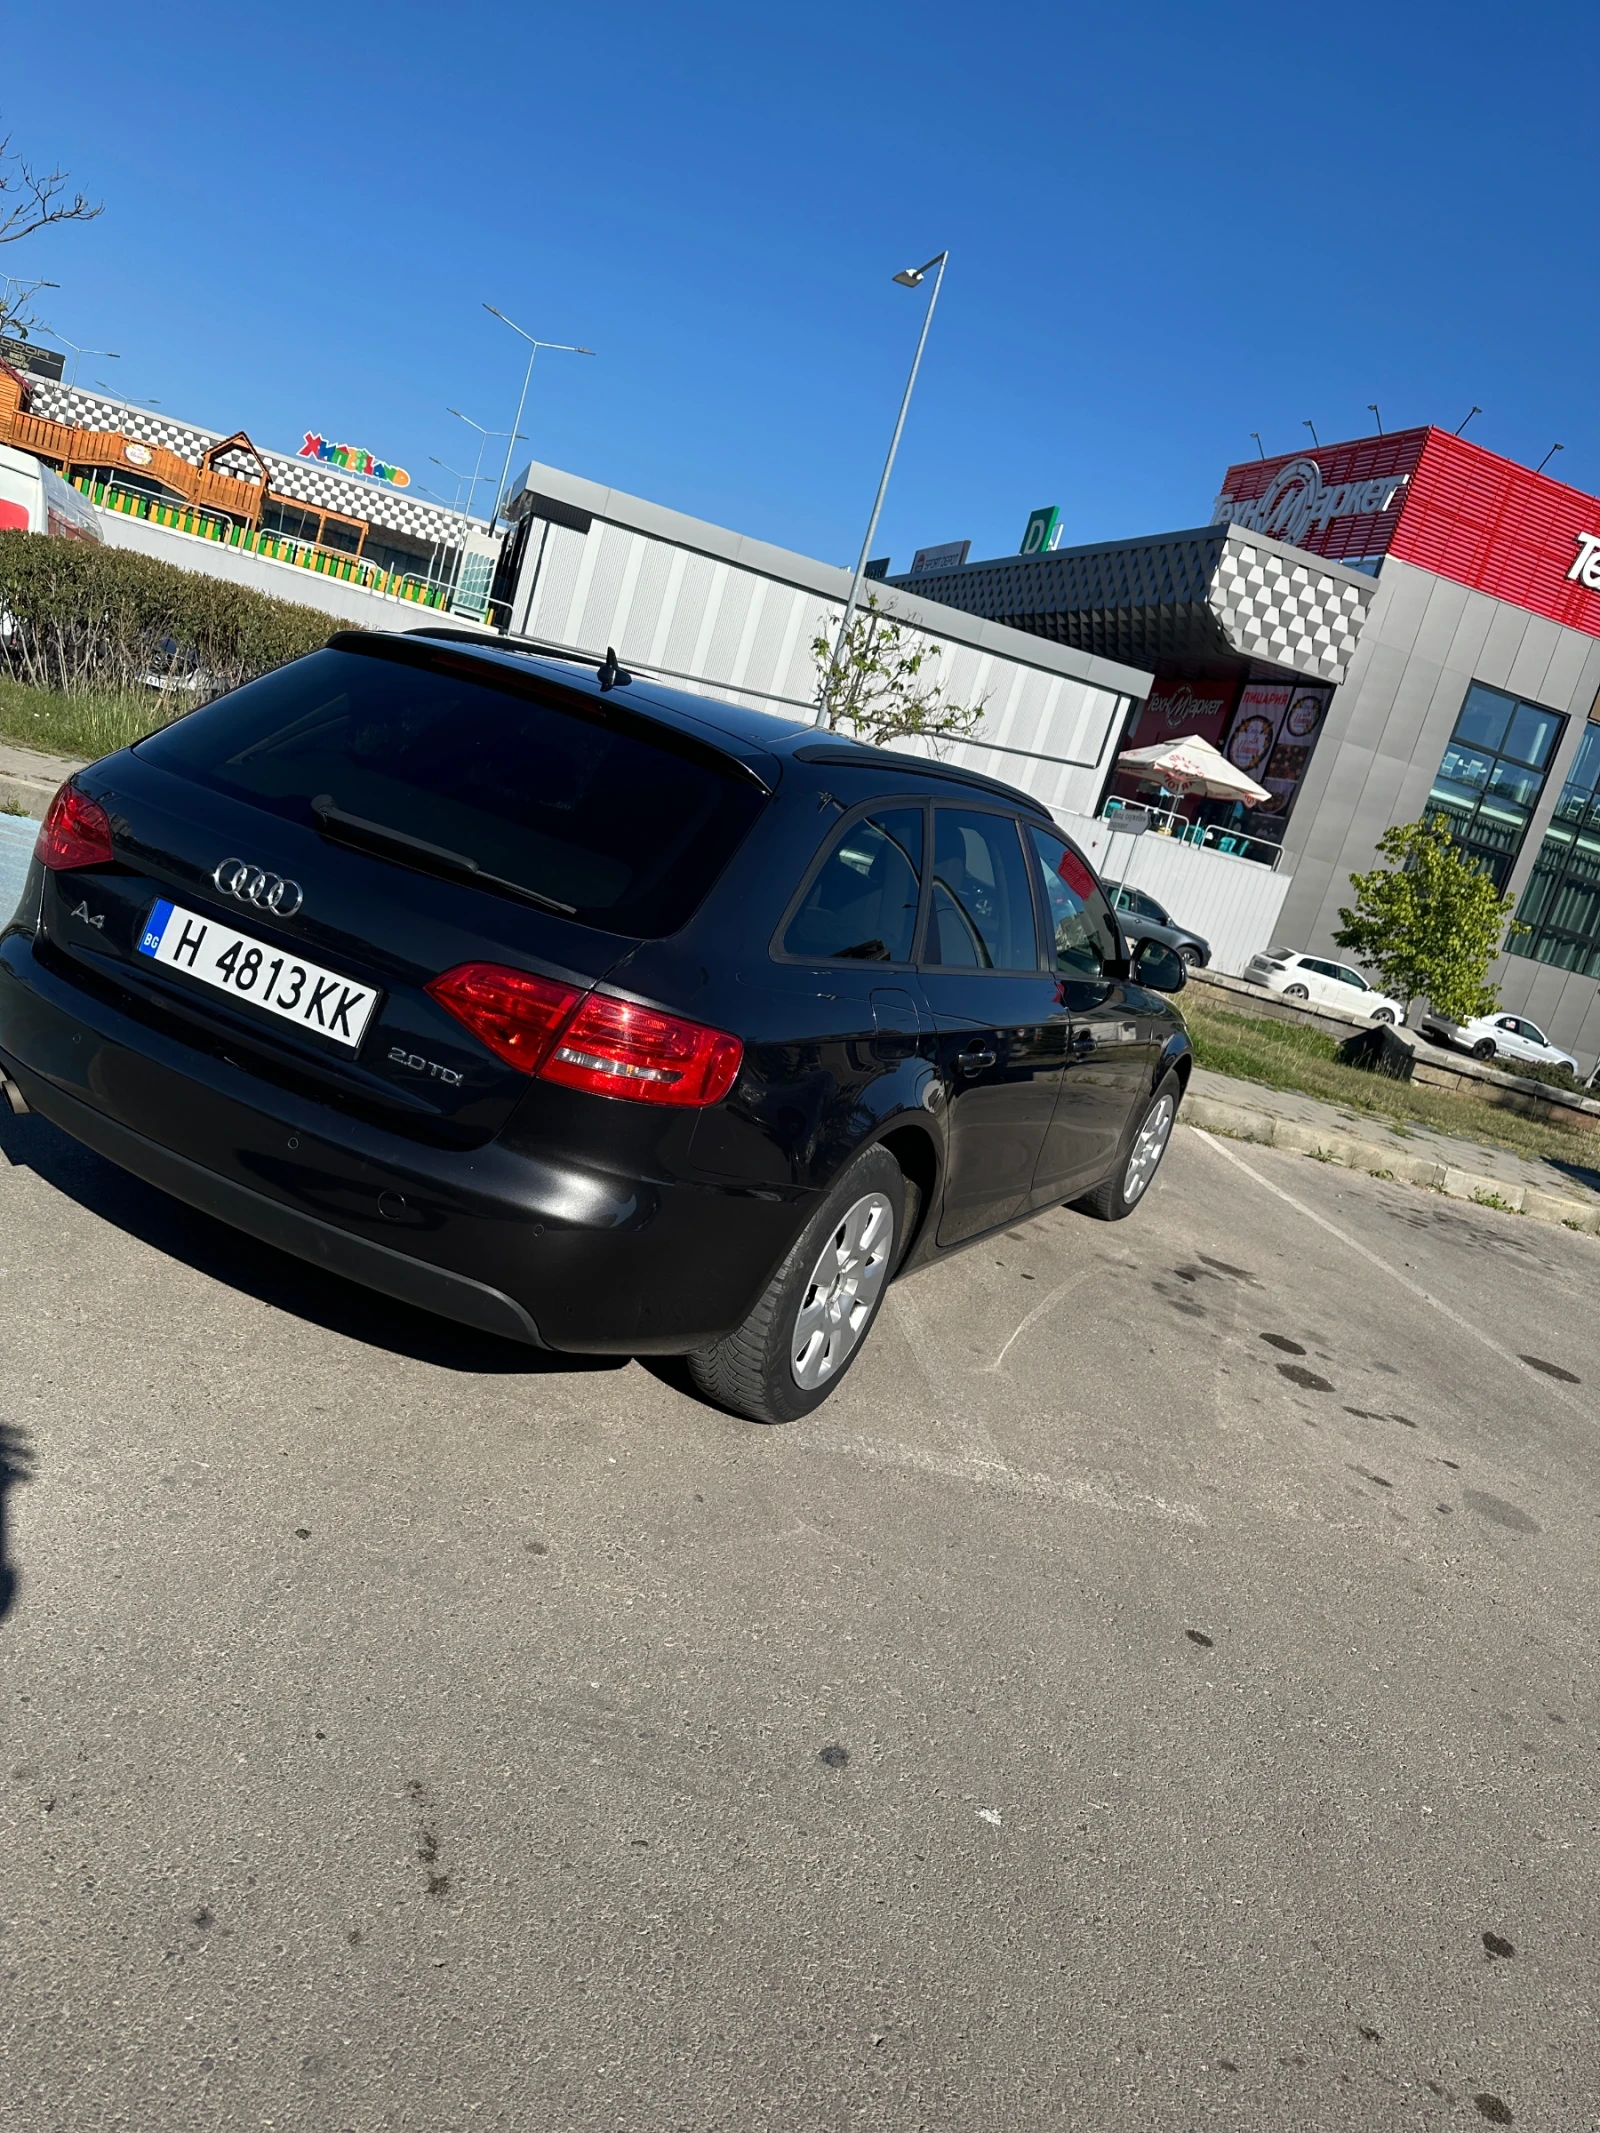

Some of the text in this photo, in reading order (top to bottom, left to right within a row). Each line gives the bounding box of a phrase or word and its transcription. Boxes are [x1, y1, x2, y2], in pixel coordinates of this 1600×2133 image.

[924, 553, 960, 571] SPORT DEPOT
[1242, 691, 1289, 705] ПИЦАРИЯ
[144, 933, 160, 949] BG
